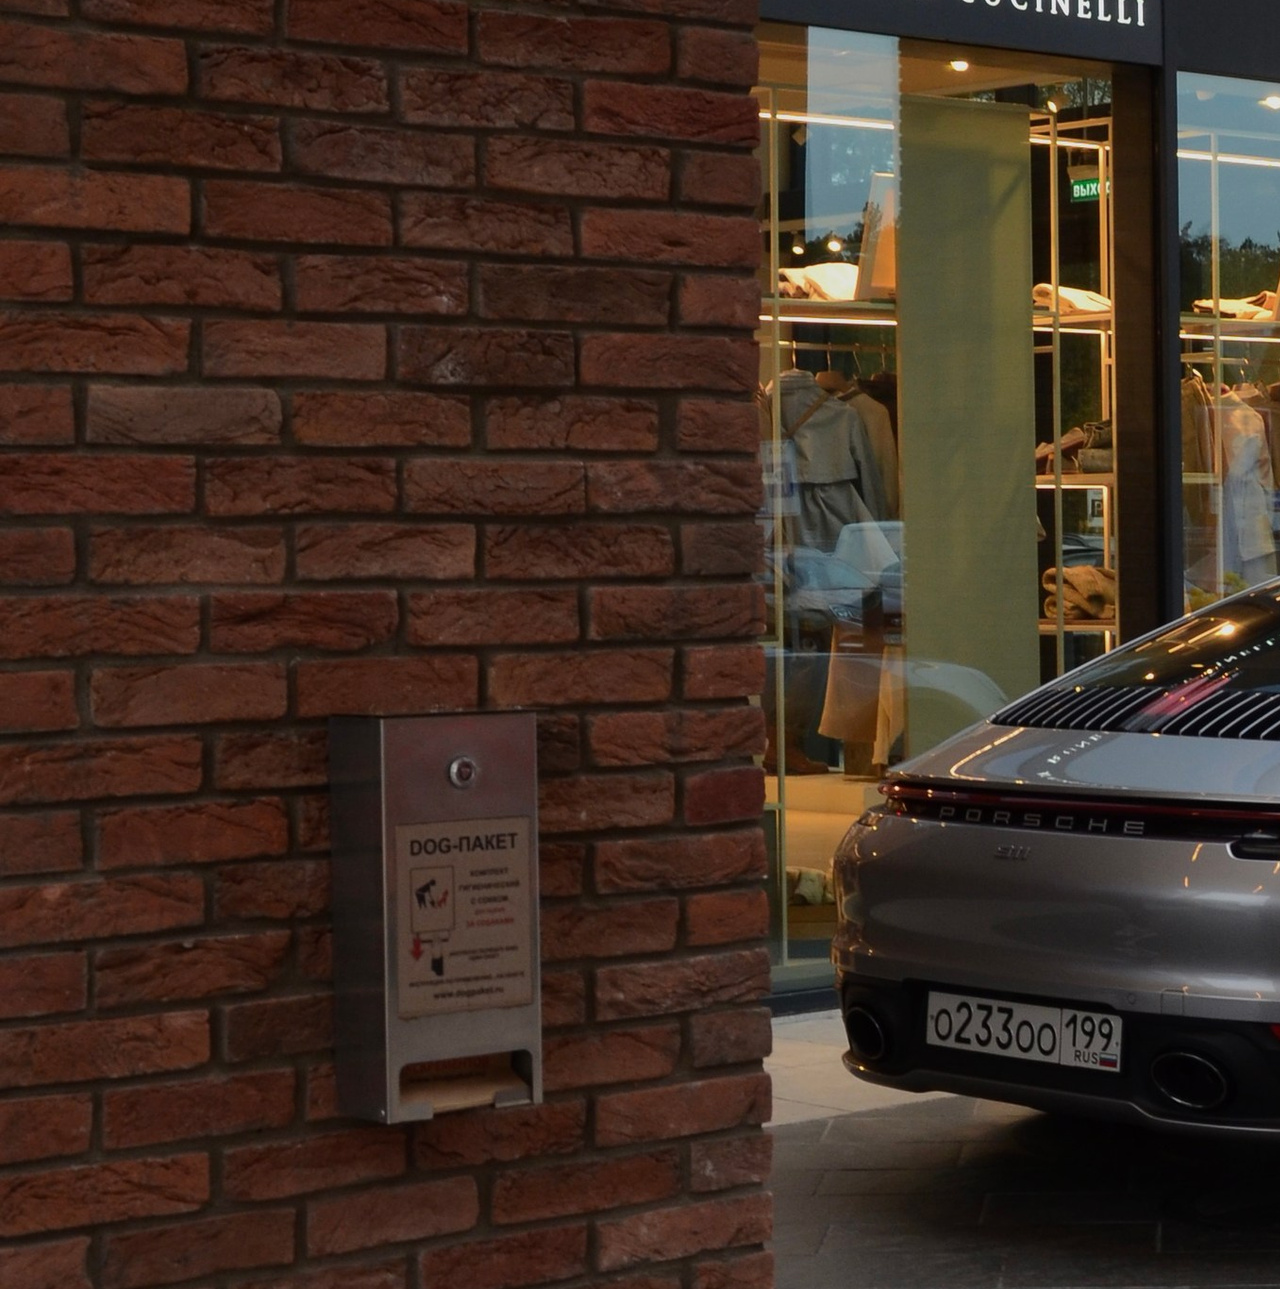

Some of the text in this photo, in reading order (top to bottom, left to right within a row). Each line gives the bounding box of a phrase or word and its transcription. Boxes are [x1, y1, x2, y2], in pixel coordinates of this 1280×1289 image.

[938, 806, 1146, 835] PORSCHE
[409, 832, 518, 856] DOG-ПАКЕТ
[1065, 1014, 1115, 1052] 199
[1073, 1049, 1099, 1065] RUS
